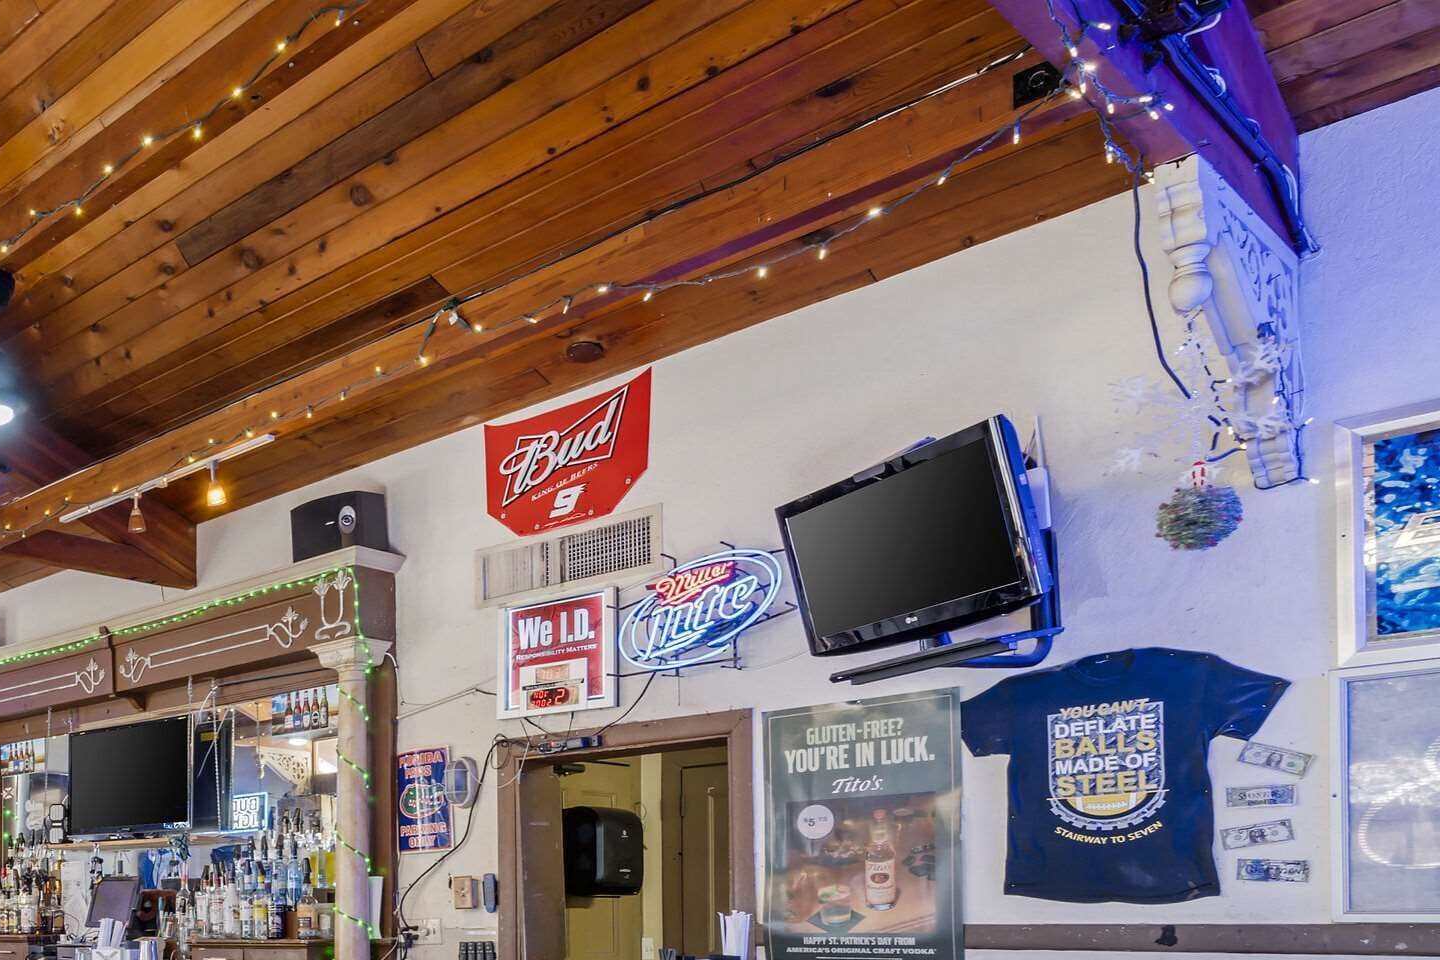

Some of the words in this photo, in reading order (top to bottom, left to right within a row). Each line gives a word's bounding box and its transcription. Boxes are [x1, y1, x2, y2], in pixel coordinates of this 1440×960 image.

[499, 397, 620, 494] Bud
[531, 486, 554, 501] KING
[555, 479, 568, 490] OF
[570, 463, 598, 481] BEERS
[549, 484, 587, 518] 9
[656, 561, 734, 604] Miller
[518, 616, 552, 650] We
[560, 608, 595, 644] I.D.
[643, 576, 757, 660] Lite
[566, 643, 598, 653] MATTERS
[1060, 704, 1094, 720] YOU
[1097, 698, 1150, 716] CAN'T
[806, 718, 904, 745] GLUTEN-FREE?
[1054, 714, 1156, 738] DEFLATE
[784, 745, 850, 774] YOU'RE
[855, 741, 874, 767] IN
[881, 736, 936, 765] LUCK.
[1055, 731, 1156, 758] BALLS
[1056, 756, 1120, 775] MADE
[1125, 752, 1156, 768] OF
[832, 775, 884, 794] Tito's
[1056, 770, 1157, 796] STEEL
[1054, 826, 1108, 845] STAIRWAY
[1111, 836, 1126, 844] TO
[1127, 821, 1163, 841] SEVEN
[803, 936, 826, 945] HAPPY
[828, 937, 838, 945] ST.
[840, 937, 876, 946] PATRICK'S
[878, 937, 892, 945] DAY
[894, 937, 915, 946] FROM
